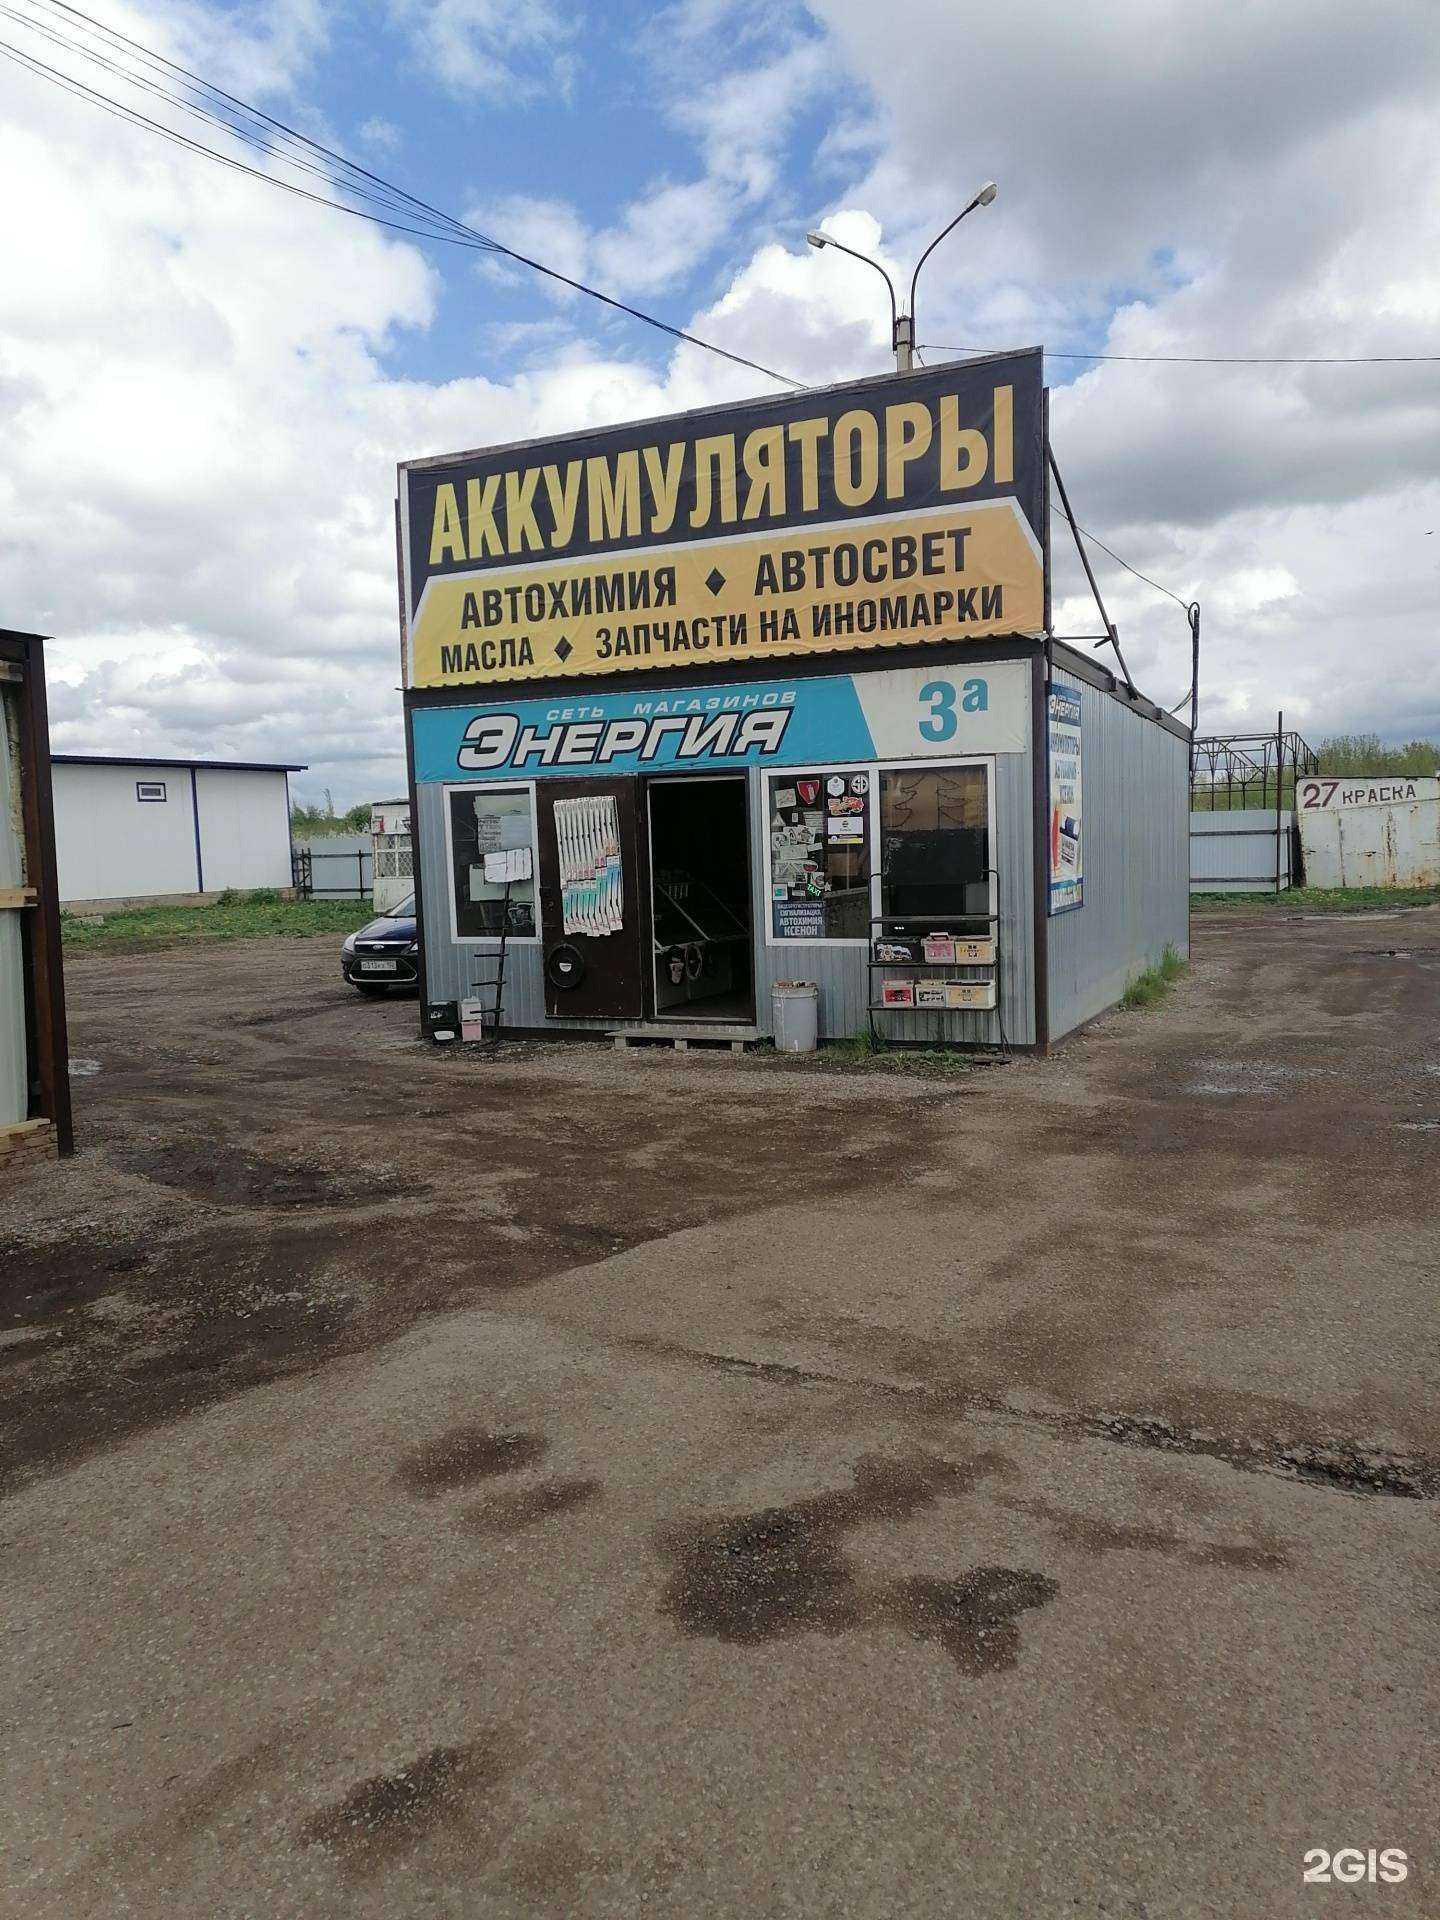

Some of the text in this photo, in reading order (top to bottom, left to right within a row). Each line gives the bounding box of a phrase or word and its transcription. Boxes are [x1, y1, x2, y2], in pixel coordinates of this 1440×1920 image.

[429, 384, 1014, 565] АККУМУЛЯТОРЫ
[754, 527, 972, 596] АВТОСВЕТ
[461, 566, 677, 629] АВТОХИМИЯ
[595, 584, 1004, 659] ЗАПЧАСТИ НА ИНОМАРКИ
[440, 637, 535, 674] МАСЛА
[546, 690, 798, 722] СЕТЬ МАГАЗИНОВ
[457, 704, 795, 771] ЭНЕРГИЯ
[1302, 781, 1417, 809] 27 КРАСКА
[779, 916, 823, 927] АВТОХИМИЯ
[784, 926, 818, 937] КСЕНОН
